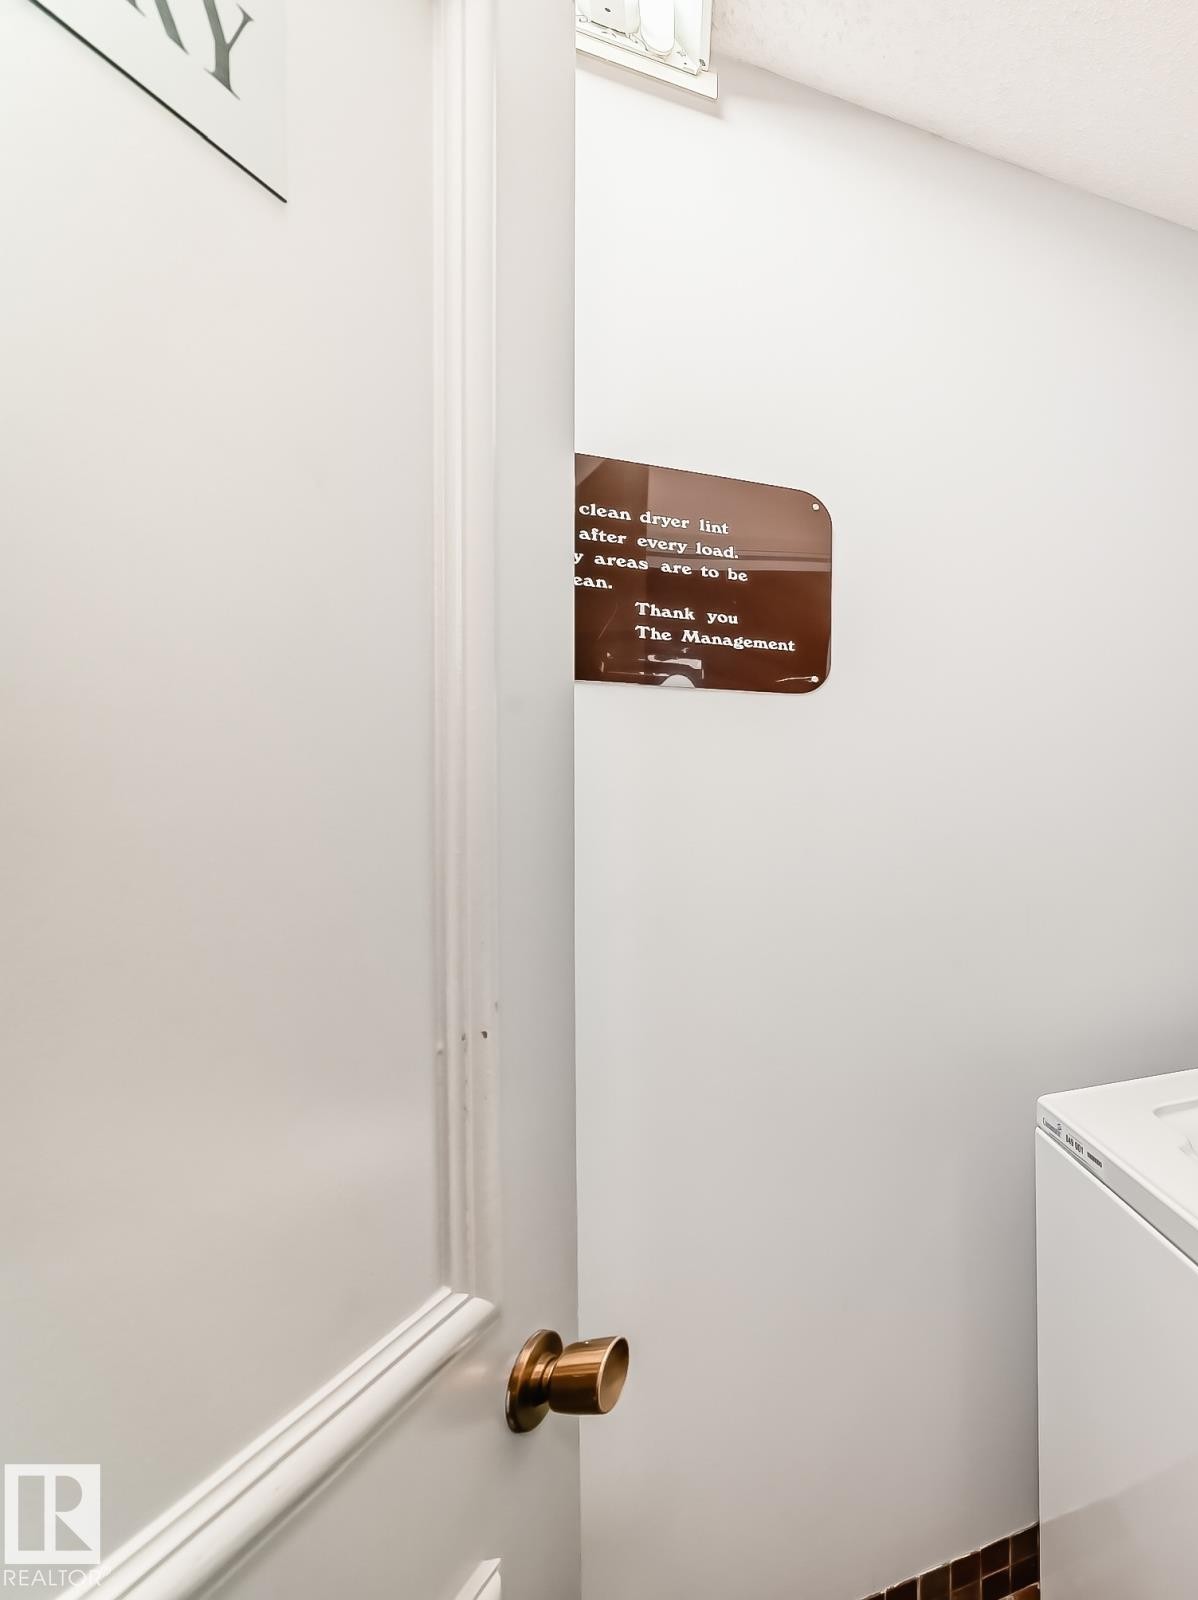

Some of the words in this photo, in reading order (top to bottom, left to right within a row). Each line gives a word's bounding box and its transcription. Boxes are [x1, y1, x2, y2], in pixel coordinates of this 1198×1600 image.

[579, 503, 632, 521] clean
[639, 511, 690, 529] dryer
[699, 519, 729, 535] lint
[579, 528, 627, 544] after
[637, 536, 687, 554] every
[696, 542, 739, 559] load.
[594, 555, 649, 570] areas
[660, 562, 692, 575] are
[700, 564, 720, 579] to
[727, 568, 748, 582] be
[635, 601, 695, 620] Thank
[706, 612, 739, 625] you
[635, 625, 672, 641] The
[681, 629, 796, 652] Management
